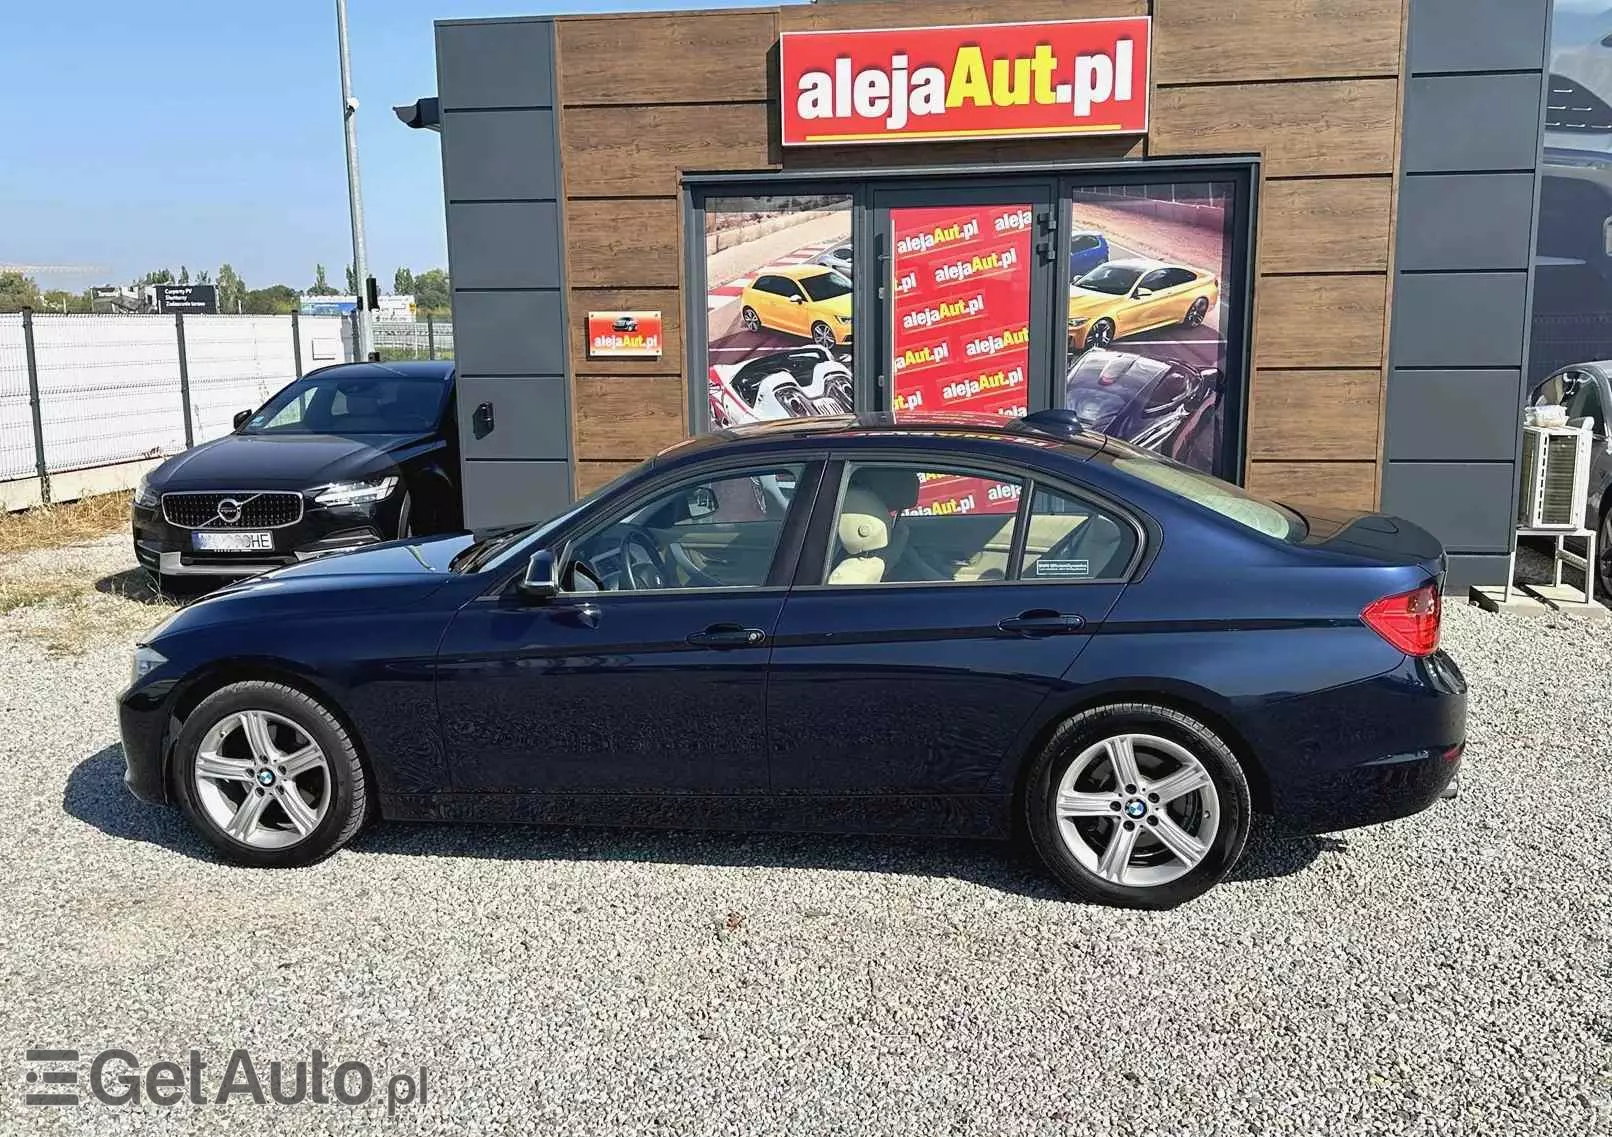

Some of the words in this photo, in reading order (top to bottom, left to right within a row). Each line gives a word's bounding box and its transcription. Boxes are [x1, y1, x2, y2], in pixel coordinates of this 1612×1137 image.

[797, 40, 1134, 130] alejaAut.pl
[897, 219, 979, 254] alejaAut.pl
[934, 247, 1017, 282] alejaAut.pl
[903, 294, 985, 328] alejaAut.pl
[594, 334, 658, 350] alejaAut.pl
[942, 367, 1024, 399] alejaAut.pl
